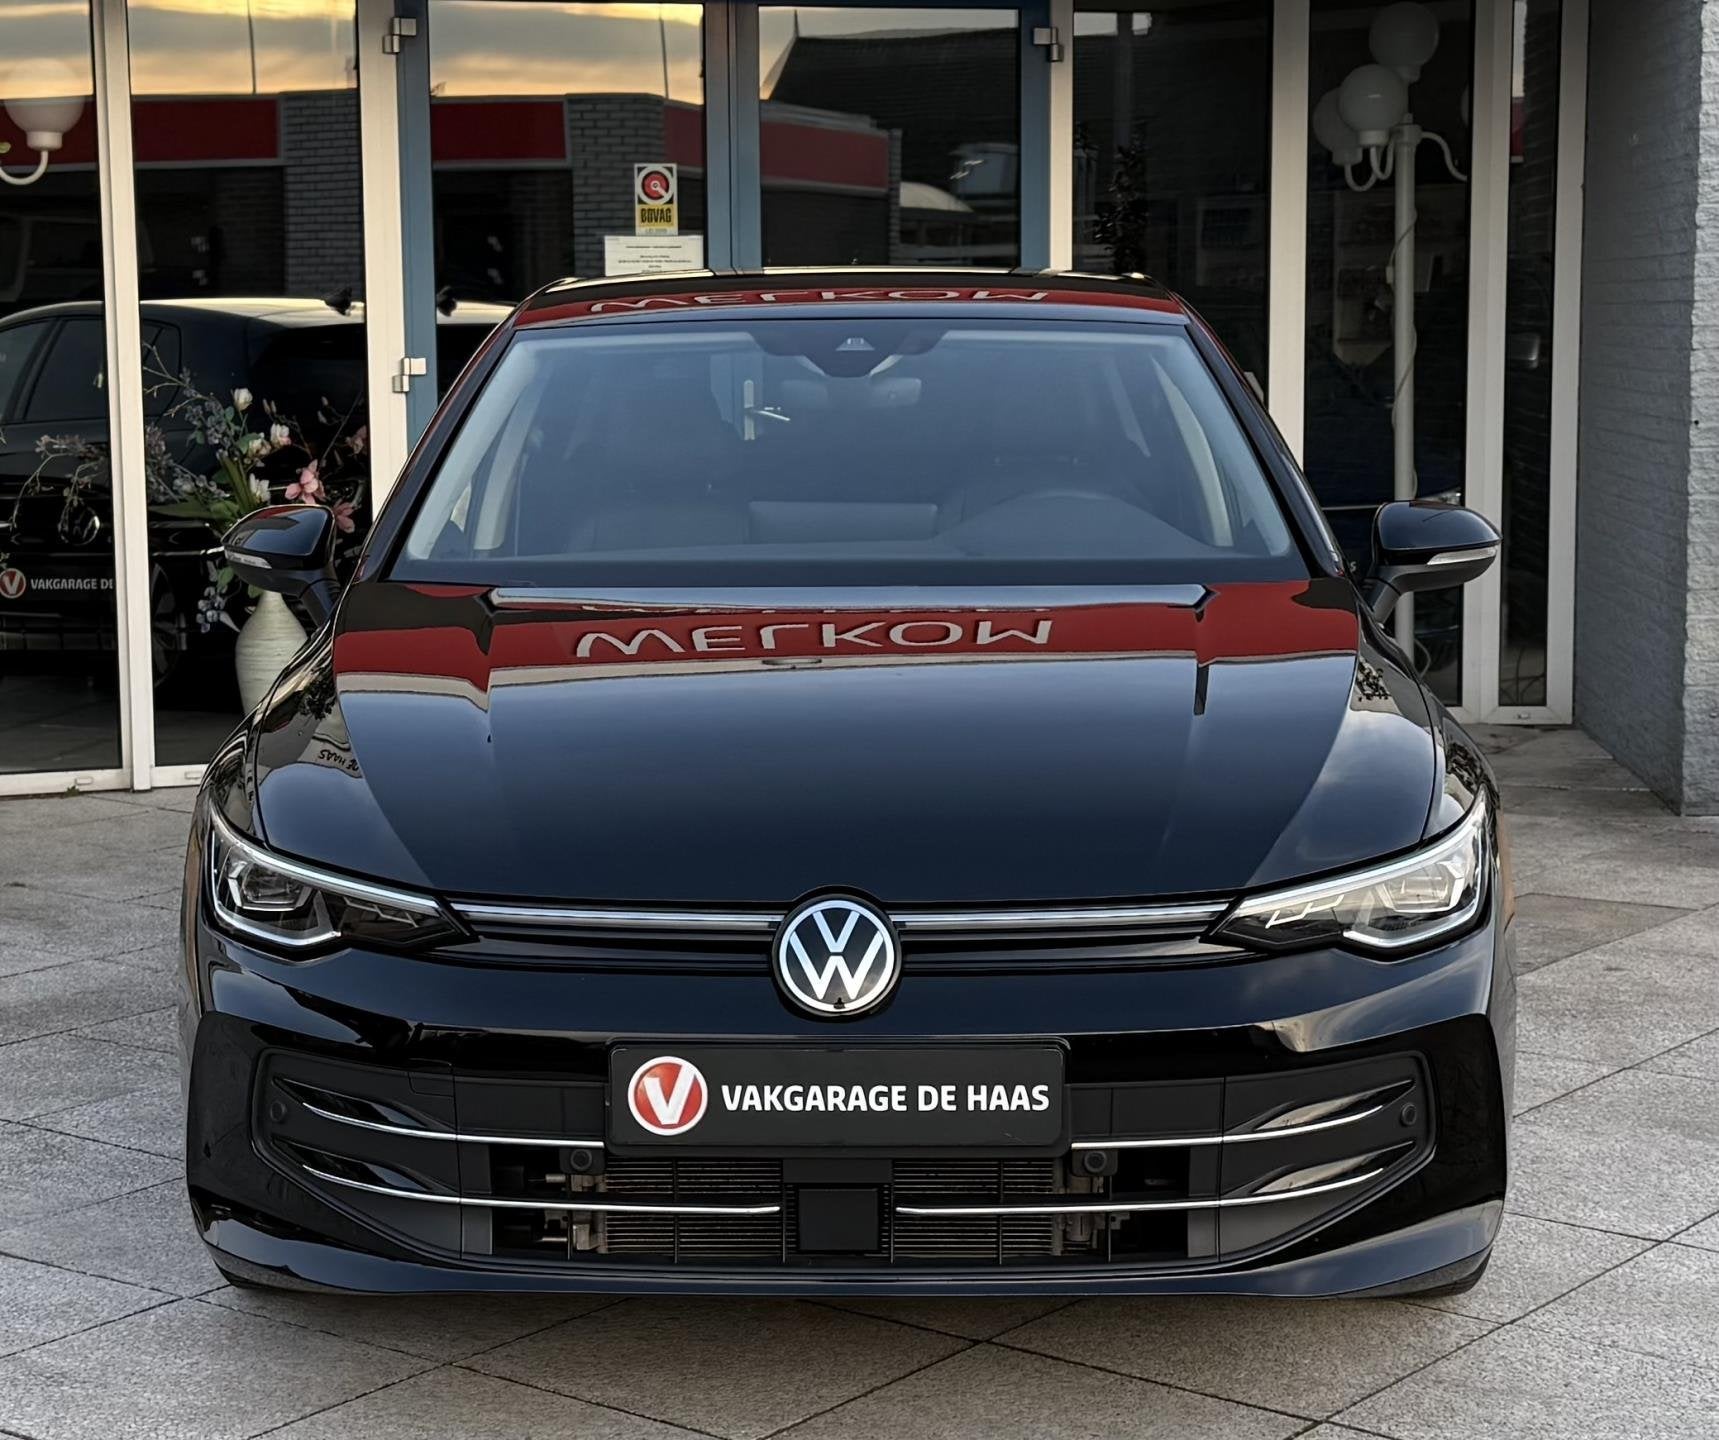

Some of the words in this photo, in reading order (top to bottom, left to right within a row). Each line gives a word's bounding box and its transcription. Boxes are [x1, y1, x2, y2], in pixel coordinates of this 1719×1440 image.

[641, 208, 671, 223] BOVAG
[30, 578, 97, 590] VAKGARAGE
[721, 1085, 908, 1112] VAKGARAGE
[918, 1085, 957, 1111] DE
[967, 1085, 1050, 1111] HAAS
